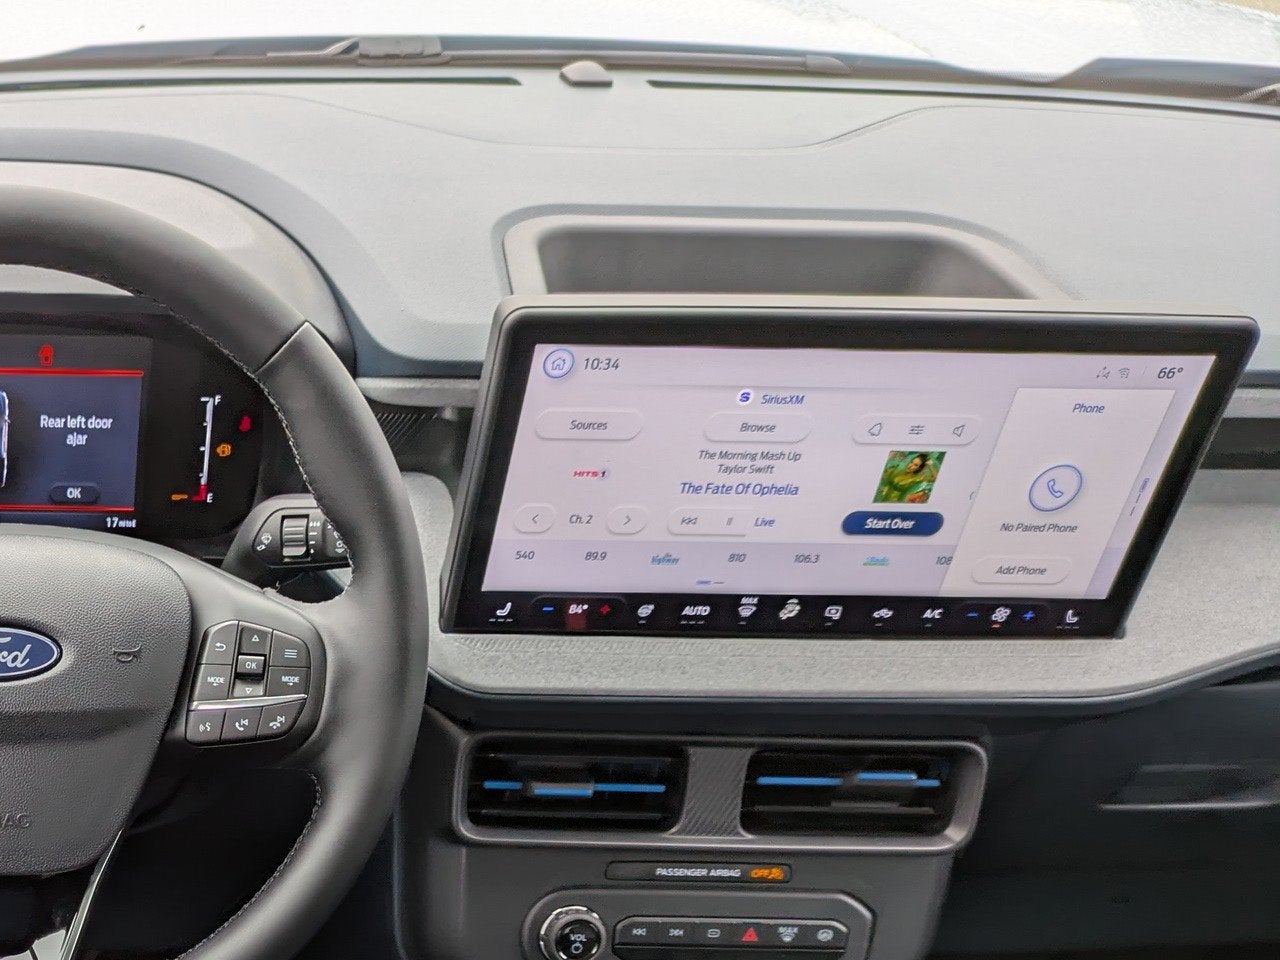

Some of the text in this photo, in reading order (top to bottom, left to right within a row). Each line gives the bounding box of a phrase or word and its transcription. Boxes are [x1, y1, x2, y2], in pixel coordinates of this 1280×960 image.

[583, 358, 620, 371] 10:34
[1157, 367, 1184, 379] 66°
[214, 395, 221, 405] F
[761, 394, 806, 405] SiriusXM
[1073, 403, 1105, 414] Phone
[40, 414, 113, 429] Rear left door
[570, 420, 608, 431] Sources
[740, 422, 777, 433] Browse
[66, 432, 88, 447] ajar
[699, 450, 802, 463] The Morning Mash Up
[718, 464, 775, 476] Taylor Swift
[66, 487, 82, 499] OK
[680, 482, 800, 498] The Fate Of Ophelia
[207, 493, 214, 503] E
[569, 514, 593, 525] Ch. 2
[754, 517, 776, 528] Live
[865, 518, 915, 530] Start Over
[1000, 522, 1078, 533] No Paired Phone
[515, 550, 536, 560] 540
[585, 551, 608, 561] 89.9
[728, 553, 747, 563] 810
[793, 553, 820, 564] 106.3
[995, 565, 1047, 576] Add Phone
[740, 597, 759, 605] MAX
[681, 605, 711, 616] AUTO
[922, 608, 944, 619] A/C
[245, 661, 257, 670] OK
[207, 676, 225, 684] MODE
[281, 675, 300, 683] MODE
[655, 867, 742, 878] PASSENGER AIRBAG
[570, 933, 587, 942] VOL
